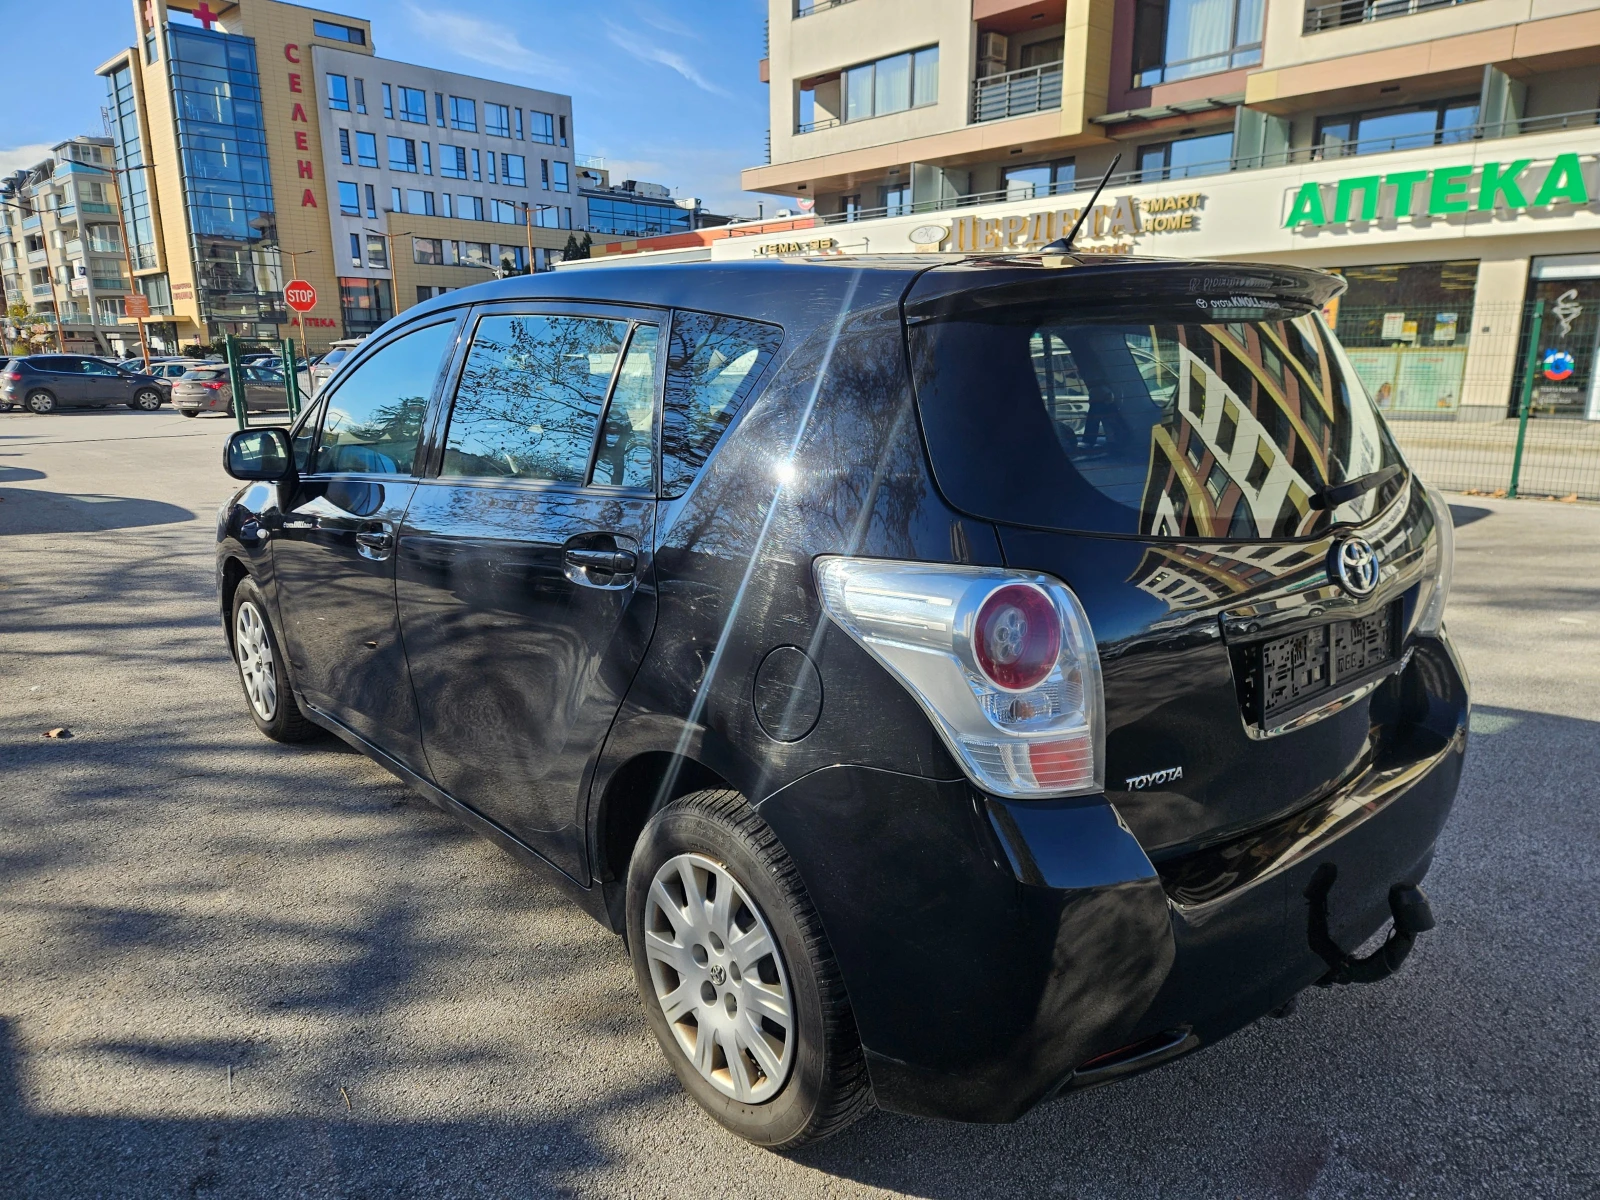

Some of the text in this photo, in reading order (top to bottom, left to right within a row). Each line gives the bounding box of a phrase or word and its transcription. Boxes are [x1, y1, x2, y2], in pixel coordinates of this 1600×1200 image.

[284, 43, 317, 208] СЕЛЕНА
[1140, 193, 1202, 213] SMART
[1284, 153, 1589, 228] АПТЕКА
[951, 195, 1140, 252] ПЕРДЕТА
[1142, 213, 1194, 232] HOME
[287, 289, 314, 303] STOP
[1125, 766, 1184, 792] TOYOTA
